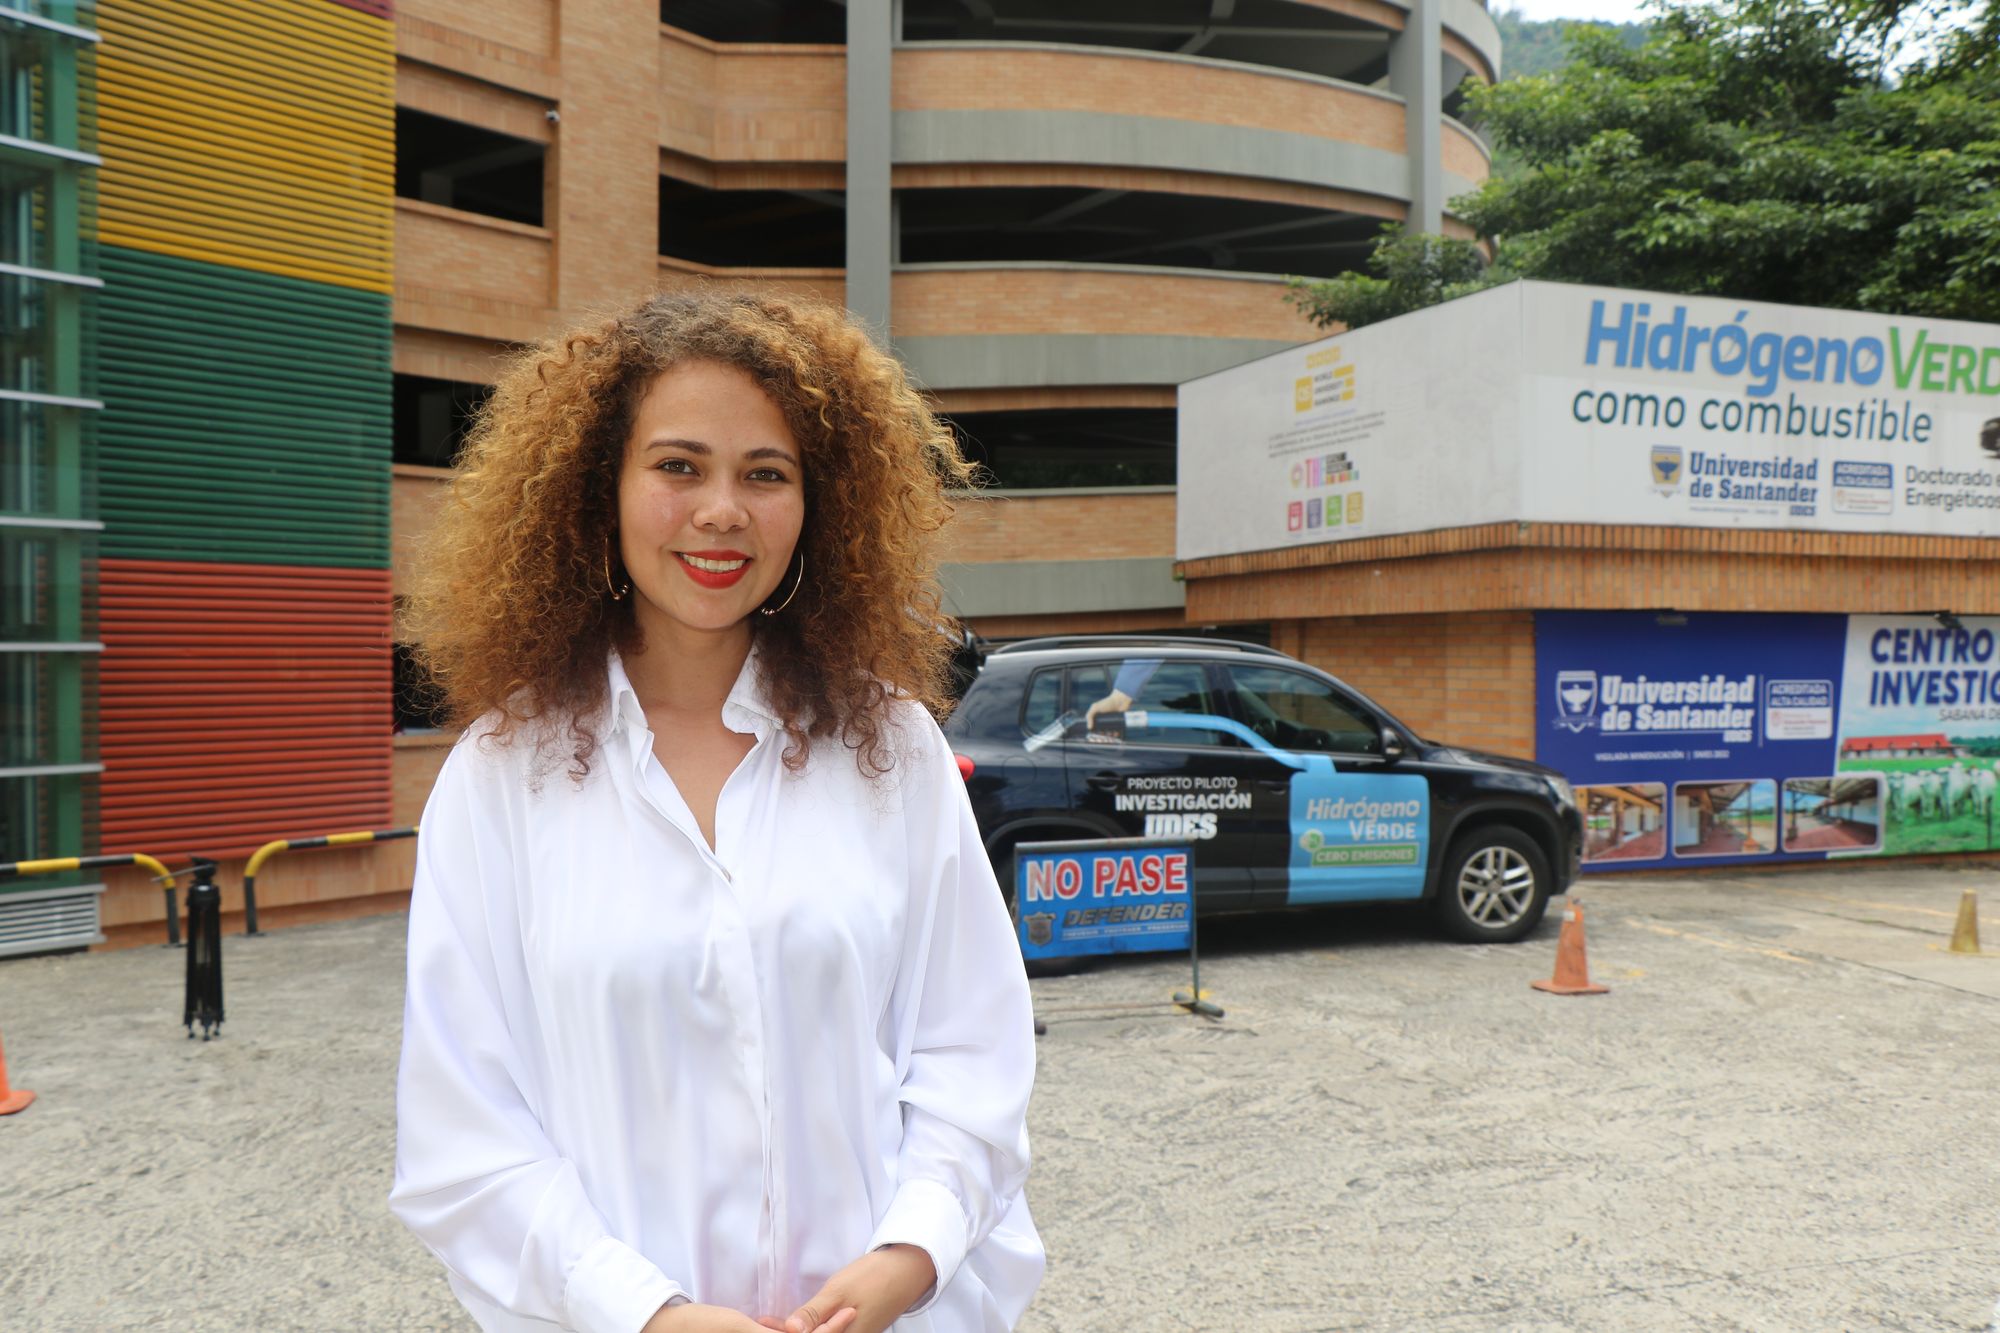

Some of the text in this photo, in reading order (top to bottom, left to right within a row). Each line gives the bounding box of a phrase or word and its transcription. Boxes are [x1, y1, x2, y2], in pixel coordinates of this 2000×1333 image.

[1572, 390, 1932, 444] como combustible
[1689, 451, 1818, 481] Universidad
[1905, 465, 1993, 487] Doctorado
[1690, 477, 1818, 503] de Santander
[1870, 628, 1995, 664] CENTRO
[1602, 674, 1756, 705] Universidad
[1601, 703, 1755, 731] de Santander
[1127, 776, 1238, 790] PROYECTO PILOTO
[1115, 788, 1252, 812] INVESTIGACIÓN
[1306, 796, 1420, 824] Hidrógeno
[1349, 820, 1416, 841] VERDE
[1316, 851, 1349, 862] CERO
[1026, 853, 1187, 902] NO PASE
[1063, 902, 1188, 928] DEFENDER
